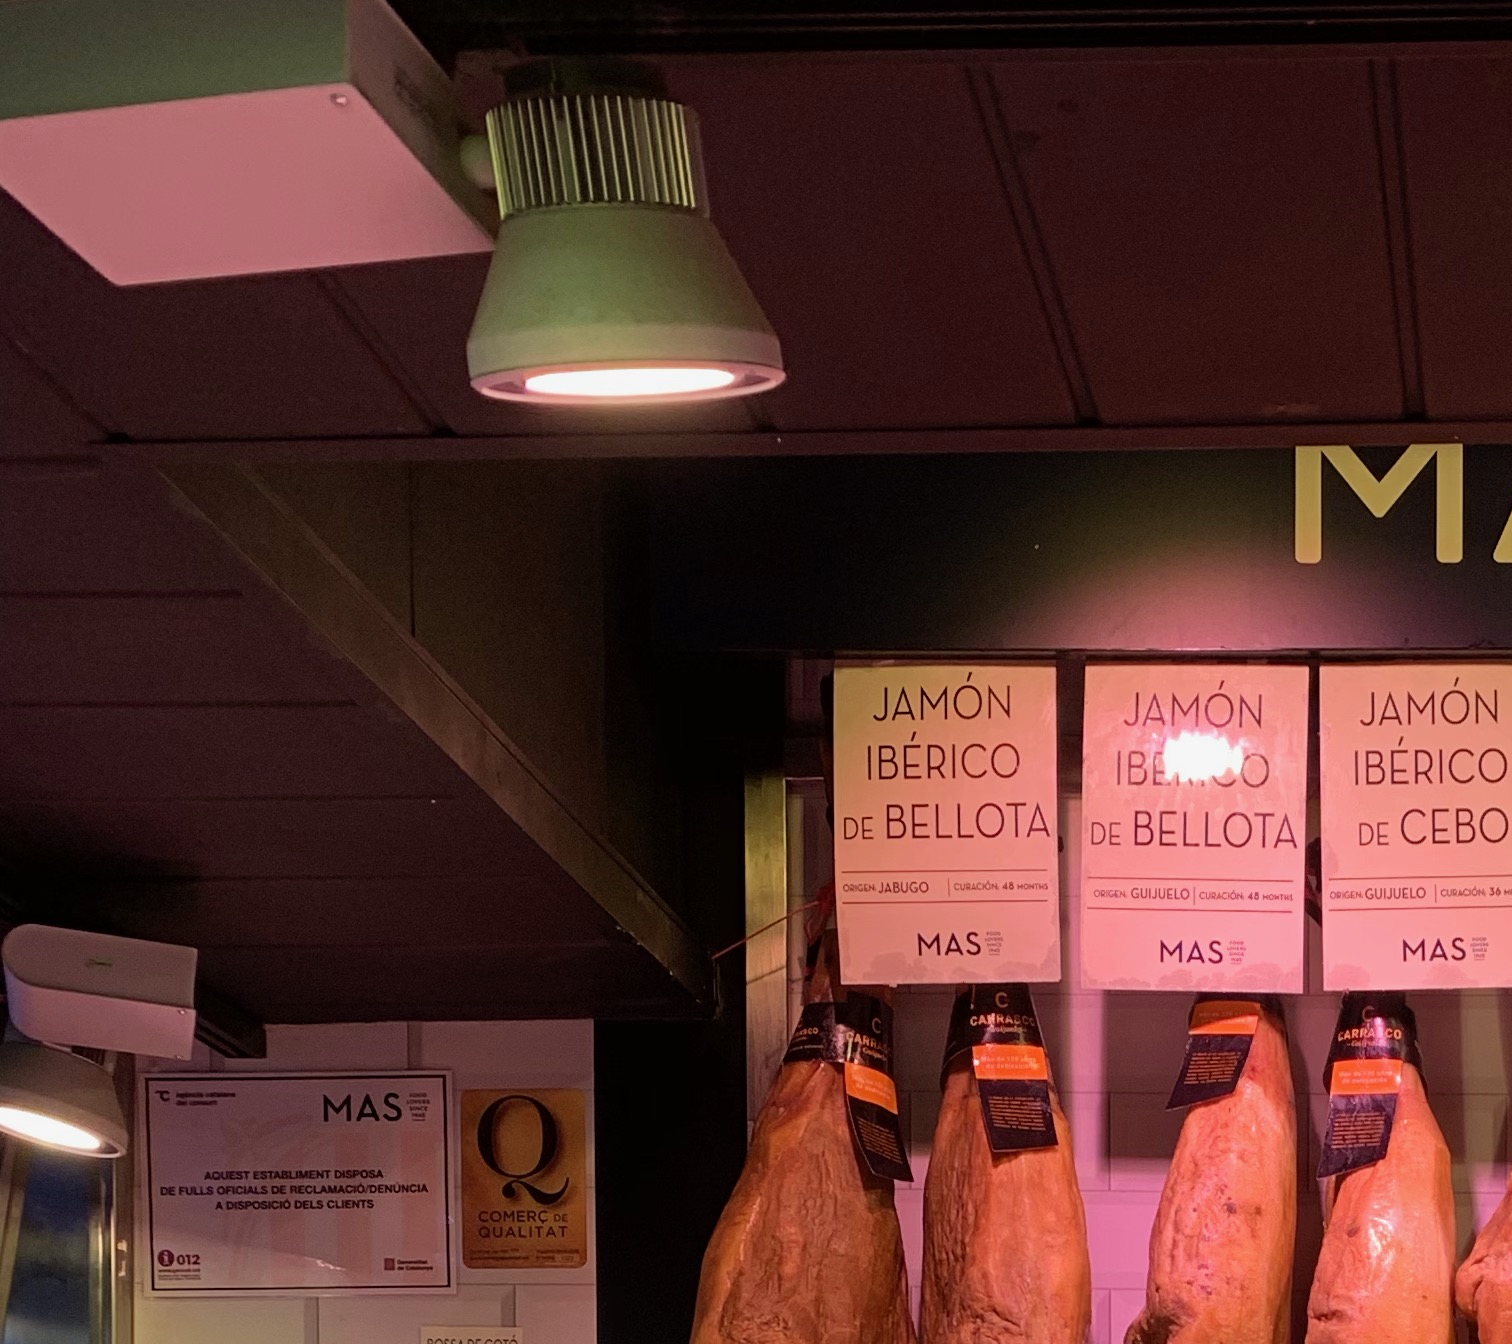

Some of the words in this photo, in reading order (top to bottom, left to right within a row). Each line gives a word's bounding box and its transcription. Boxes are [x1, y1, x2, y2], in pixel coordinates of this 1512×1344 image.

[873, 672, 1011, 722] JAMÓN
[1360, 678, 1498, 726] JAMÓN
[867, 733, 1020, 780] IBÉRICO
[1354, 738, 1508, 784] IBÉRICO
[843, 816, 875, 841] DE
[886, 803, 1051, 839] BELLOTA
[1358, 821, 1390, 846] DE
[1401, 808, 1509, 844] CEBO
[878, 880, 930, 895] JABUGO
[1001, 880, 1015, 892] 48
[1017, 881, 1049, 891] MONTHS
[1364, 886, 1427, 900] GUIJUELO
[917, 932, 982, 957] MAS
[1401, 937, 1467, 962] MAS
[324, 1092, 401, 1121] MAS
[203, 1169, 250, 1181] AQUEST
[253, 1169, 331, 1181] ESTABLIMENT
[333, 1168, 384, 1180] DISPOSA
[159, 1185, 177, 1197] DE
[178, 1185, 214, 1197] FULLS
[215, 1184, 268, 1196] OFICIALS
[270, 1184, 286, 1196] DE
[293, 1199, 324, 1211] DELS
[326, 1199, 375, 1210] CLIENTS
[477, 1209, 550, 1225] COMERÇ
[552, 1212, 569, 1223] DE
[477, 1225, 569, 1240] QUALITAT
[176, 1253, 201, 1266] 012
